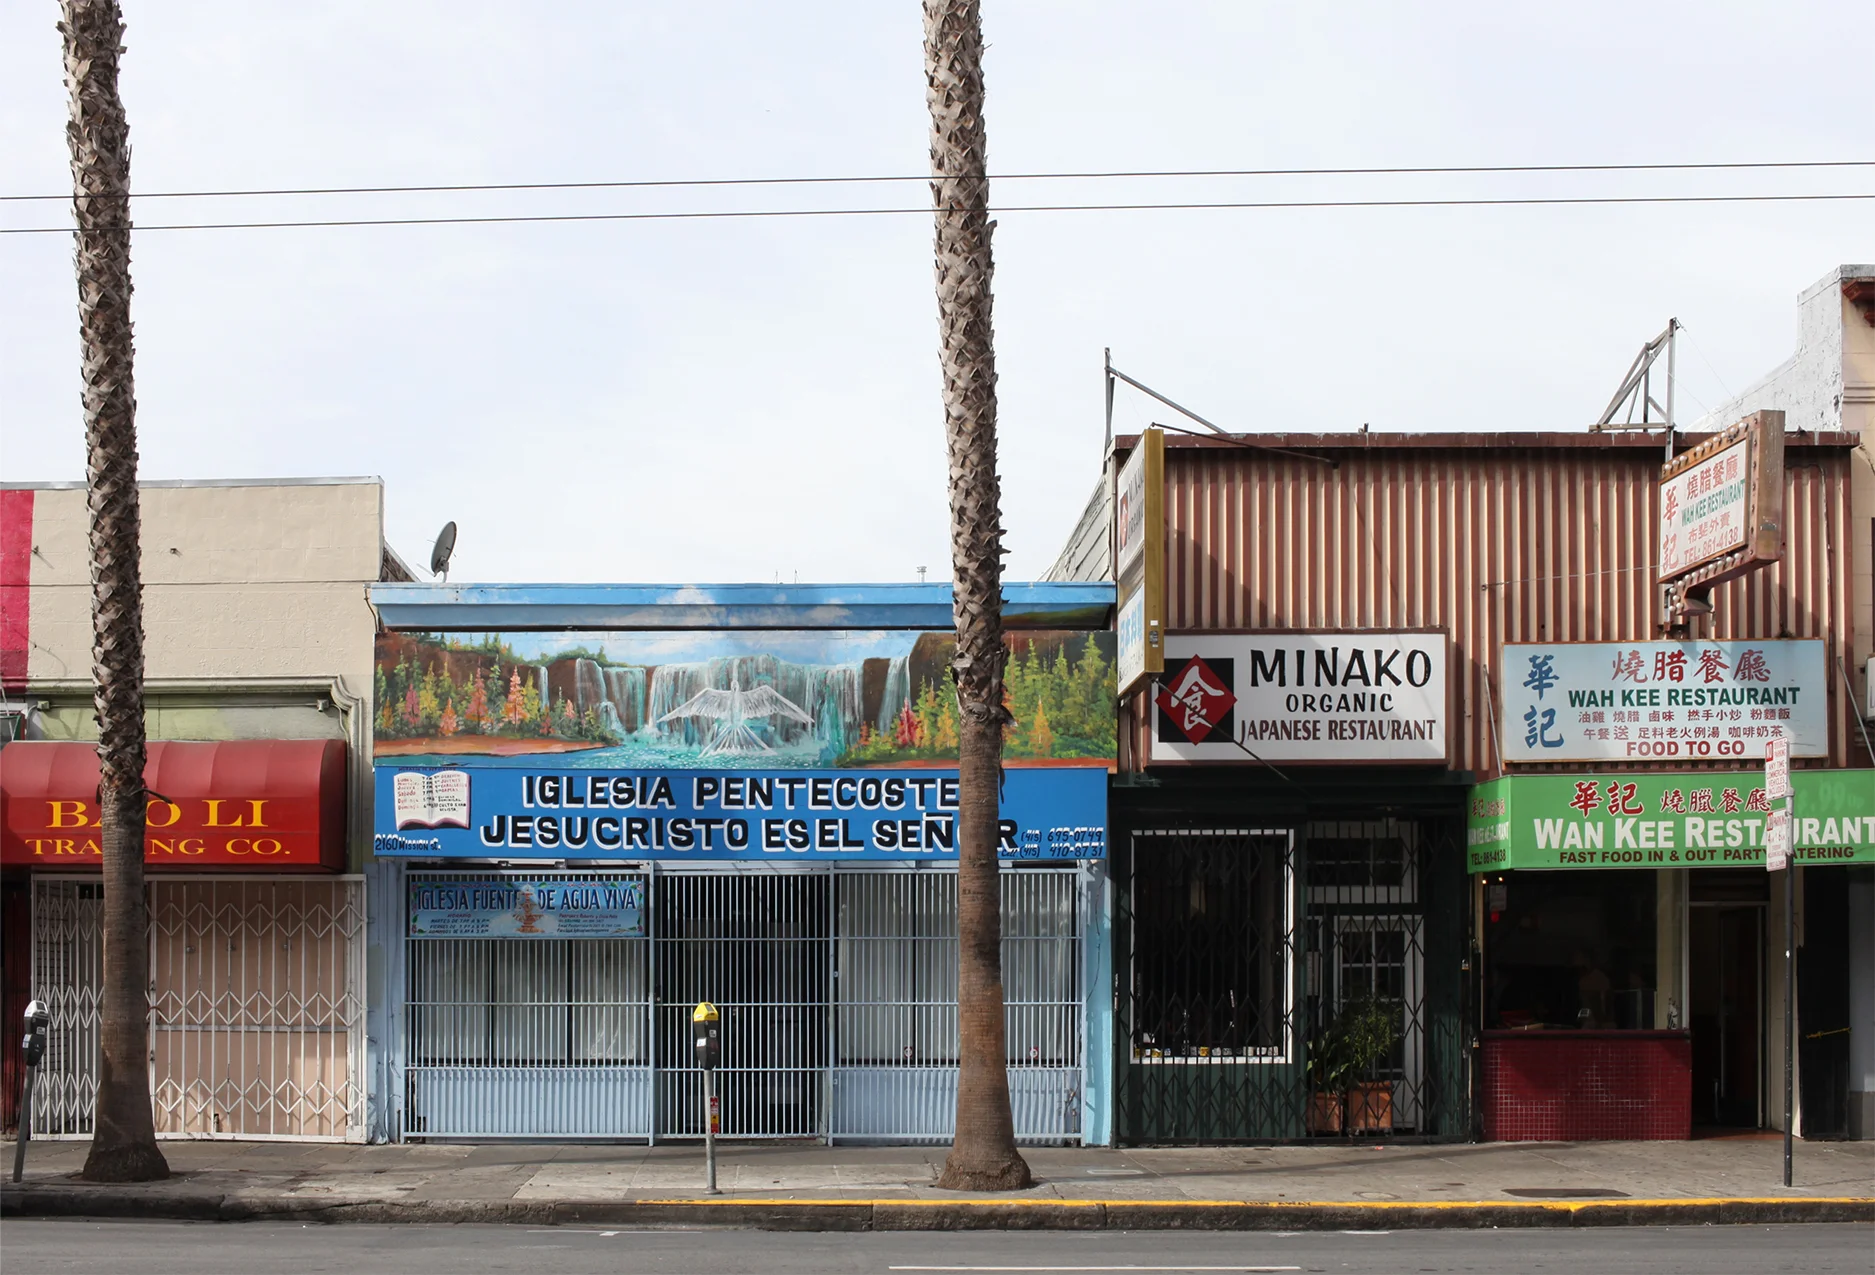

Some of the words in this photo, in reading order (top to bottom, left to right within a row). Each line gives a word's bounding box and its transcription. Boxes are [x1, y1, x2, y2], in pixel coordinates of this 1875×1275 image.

[1682, 501, 1694, 527] WAH
[1695, 497, 1707, 518] KEE
[1707, 479, 1745, 515] RESTAURANT
[1250, 646, 1432, 688] MINAKO
[1285, 692, 1394, 713] ORGANIC
[1523, 654, 1565, 749] 華記
[1568, 689, 1614, 708] WAH
[1621, 688, 1660, 707] KEE
[1668, 686, 1800, 706] RESTAURANT
[1239, 719, 1321, 745] JAPANESE
[1327, 719, 1437, 741] RESTAURANT
[1627, 741, 1679, 756] FOOD
[1685, 740, 1711, 756] TO
[1717, 740, 1745, 755] GO
[522, 775, 677, 809] IGLESIA
[1569, 781, 1644, 819] 華記
[46, 800, 182, 828] BO
[201, 800, 269, 827] LI
[375, 833, 399, 851] 2160
[480, 815, 748, 850] JESUCRISTO
[761, 818, 810, 852] ES
[815, 818, 865, 852] EL
[872, 811, 1019, 853] SEÑR
[1021, 829, 1042, 843] (415)
[1047, 827, 1104, 842] 695-0749
[1533, 819, 1604, 849] WAN
[1614, 818, 1675, 849] KEE
[1684, 816, 1875, 848] RESTRANT
[25, 839, 207, 855] TRANG
[226, 838, 291, 855] CO.
[1020, 843, 1040, 858] (415)
[1048, 842, 1105, 857] 410-8731
[1559, 852, 1597, 863] FAST
[1602, 851, 1643, 862] FOOD
[1648, 850, 1664, 862] IN
[1669, 850, 1680, 861] &
[1690, 850, 1717, 861] OUT
[1793, 846, 1854, 859] TERING
[418, 889, 470, 911] IGLESIA
[473, 889, 521, 911] FUENTE
[538, 889, 556, 911] DE
[561, 889, 601, 911] AGUA
[604, 889, 637, 911] VIVA
